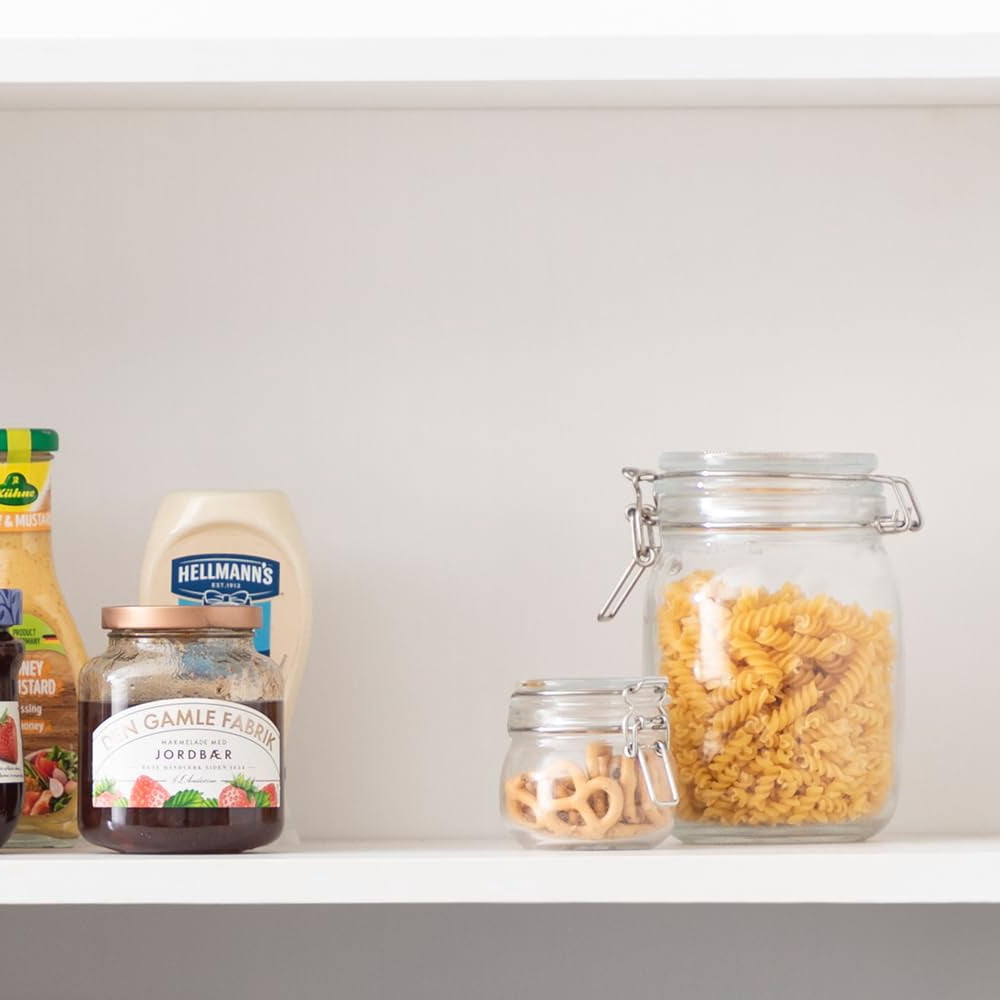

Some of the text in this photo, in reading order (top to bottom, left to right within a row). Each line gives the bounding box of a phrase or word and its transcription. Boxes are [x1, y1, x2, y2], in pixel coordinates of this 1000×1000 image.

[5, 514, 13, 528] &
[178, 562, 273, 585] HELLMANN'S
[13, 628, 36, 637] PRODUCT
[18, 660, 44, 676] NEY
[18, 679, 56, 696] STARD
[20, 703, 42, 716] ssing
[144, 710, 216, 730] GAMLE
[222, 712, 277, 752] FABRIK
[155, 749, 232, 760] JORDBÆR
